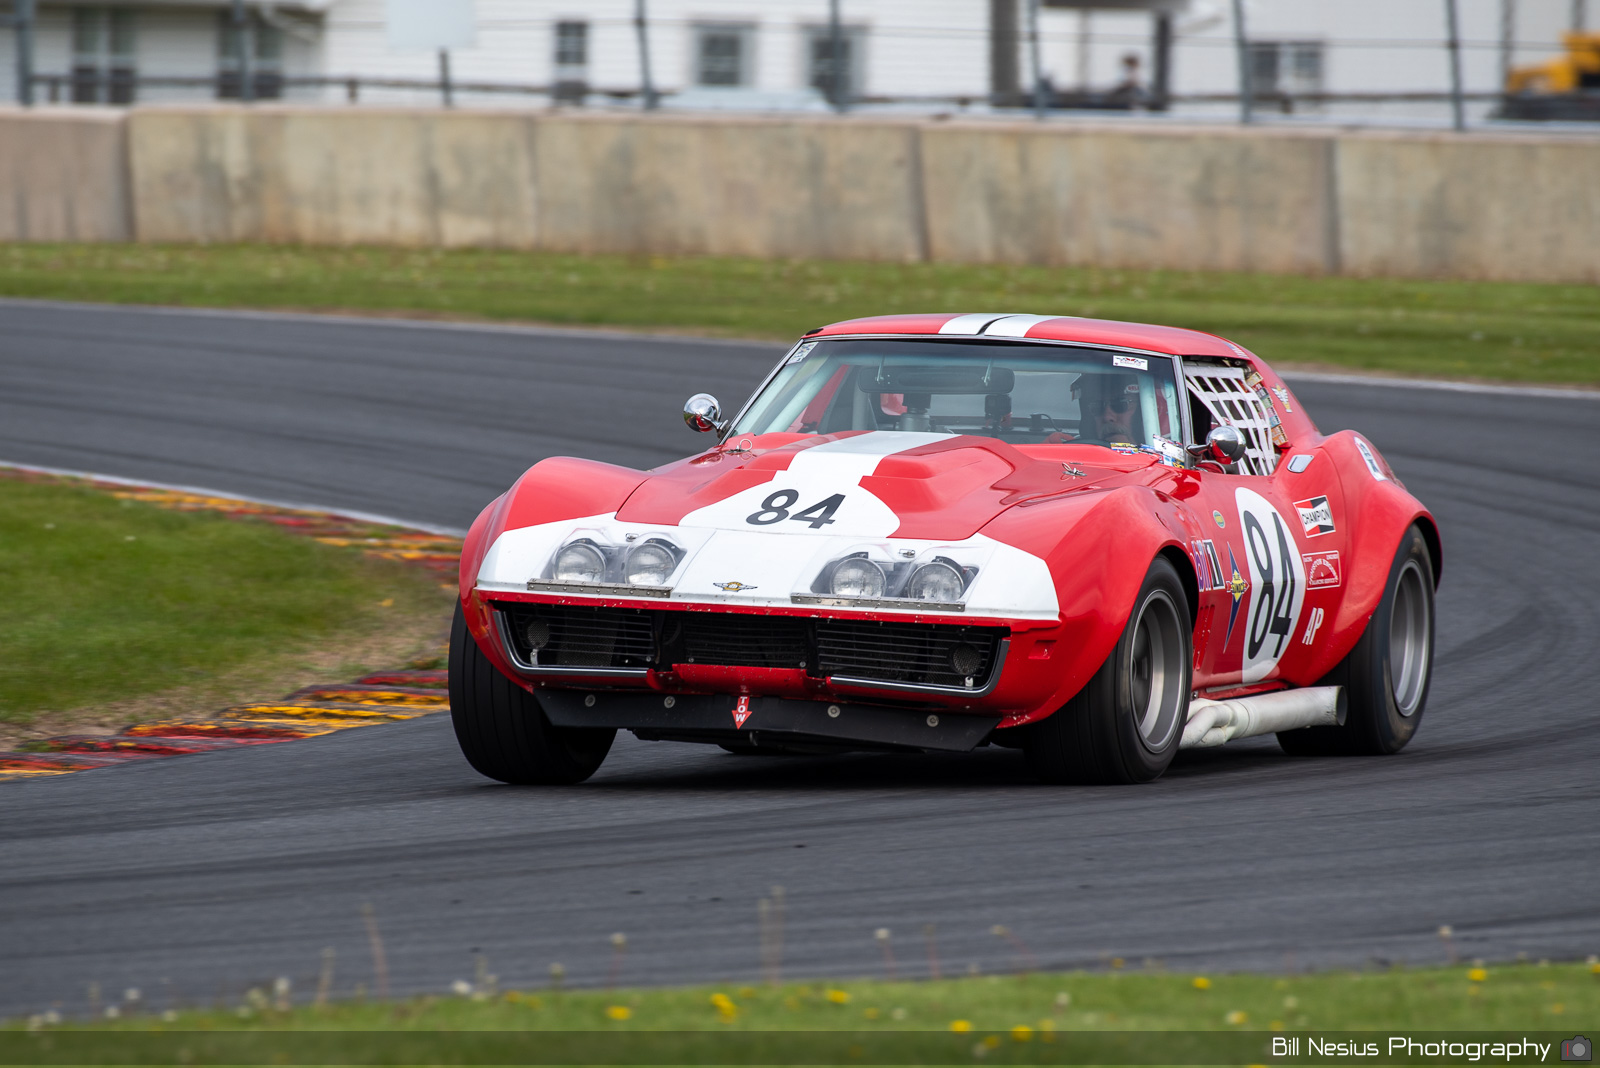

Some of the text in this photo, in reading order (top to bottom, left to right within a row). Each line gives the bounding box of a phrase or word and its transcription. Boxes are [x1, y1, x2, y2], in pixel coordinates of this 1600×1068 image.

[745, 488, 846, 529] 84
[1302, 508, 1331, 525] CHAMPION
[1243, 510, 1295, 660] 84
[1302, 607, 1325, 646] AP
[735, 696, 748, 722] TOW
